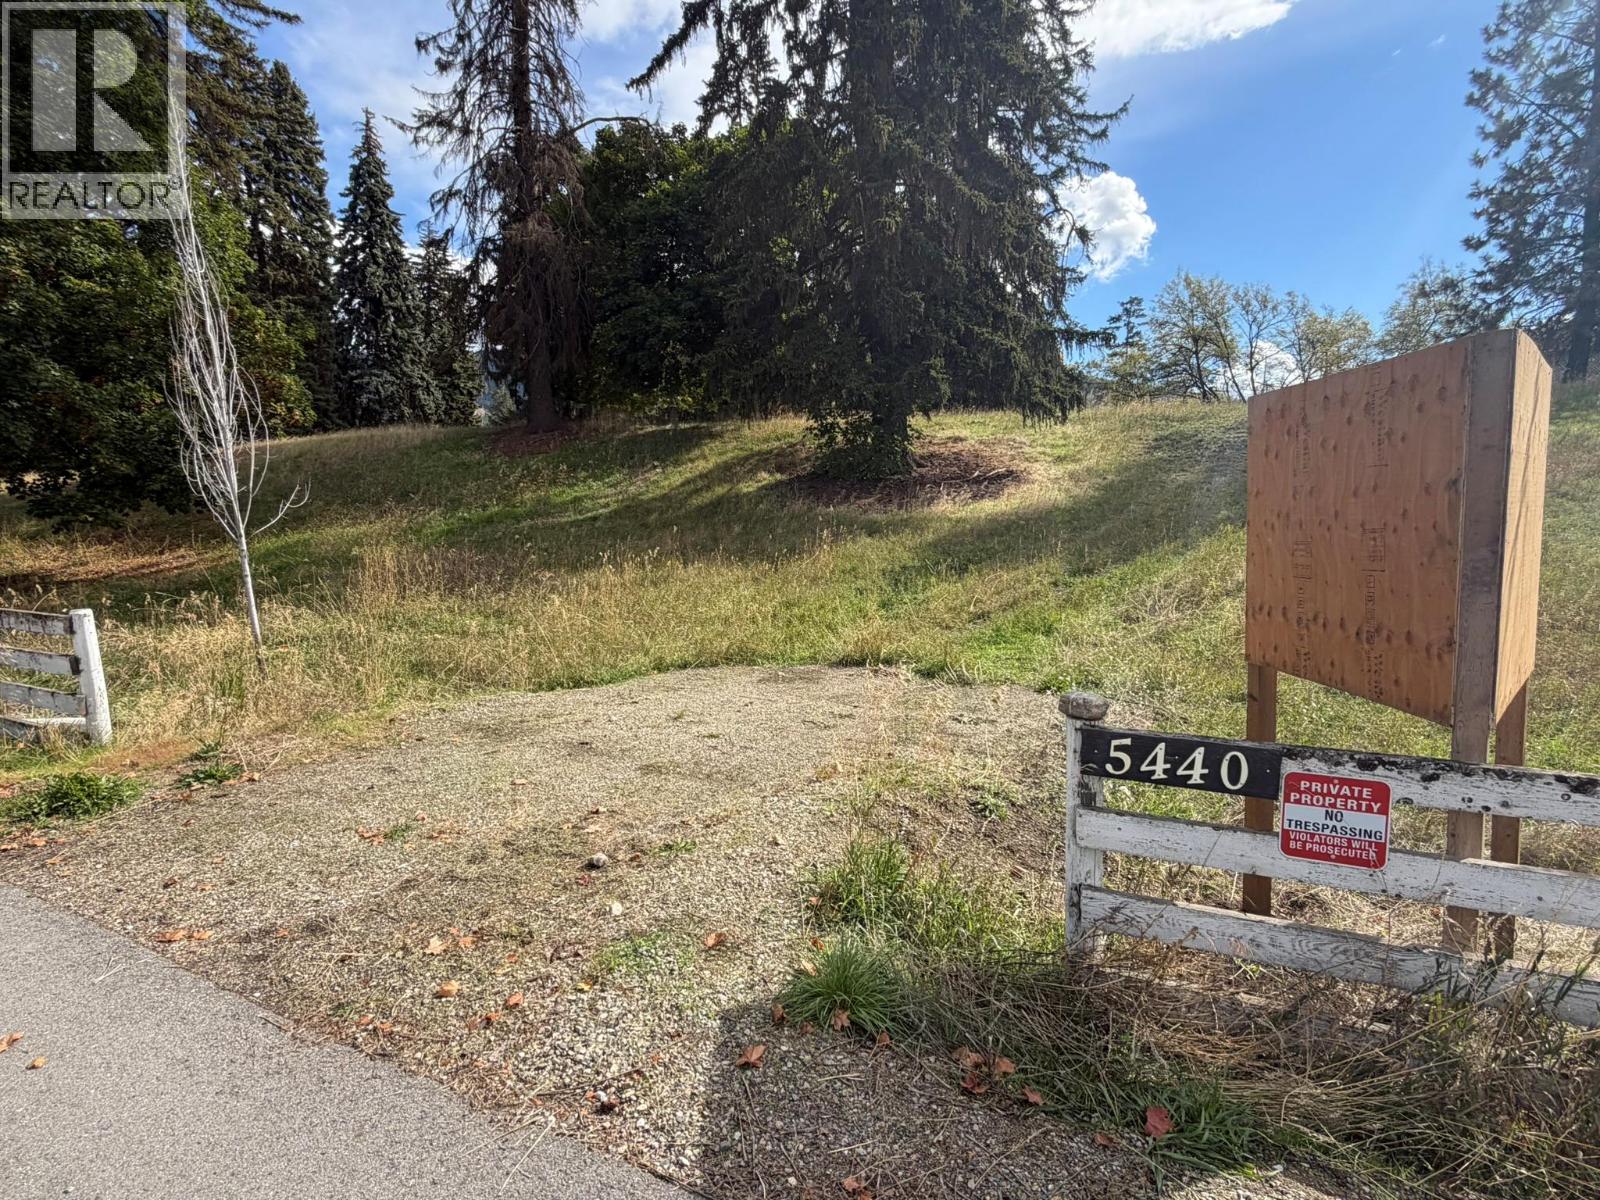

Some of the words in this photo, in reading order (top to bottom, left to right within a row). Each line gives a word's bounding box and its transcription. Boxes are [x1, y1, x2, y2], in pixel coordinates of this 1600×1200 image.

[1104, 737, 1249, 791] 5440
[1300, 780, 1373, 799] PRIVATE
[1290, 792, 1382, 813] PROPERTY
[1324, 809, 1344, 823] NO
[1286, 818, 1383, 841] TRESPASSING
[1289, 831, 1348, 847] VIOLATORS
[1351, 840, 1378, 851] WILL
[1289, 841, 1303, 850] BE
[1305, 843, 1376, 860] PROSECUTED
